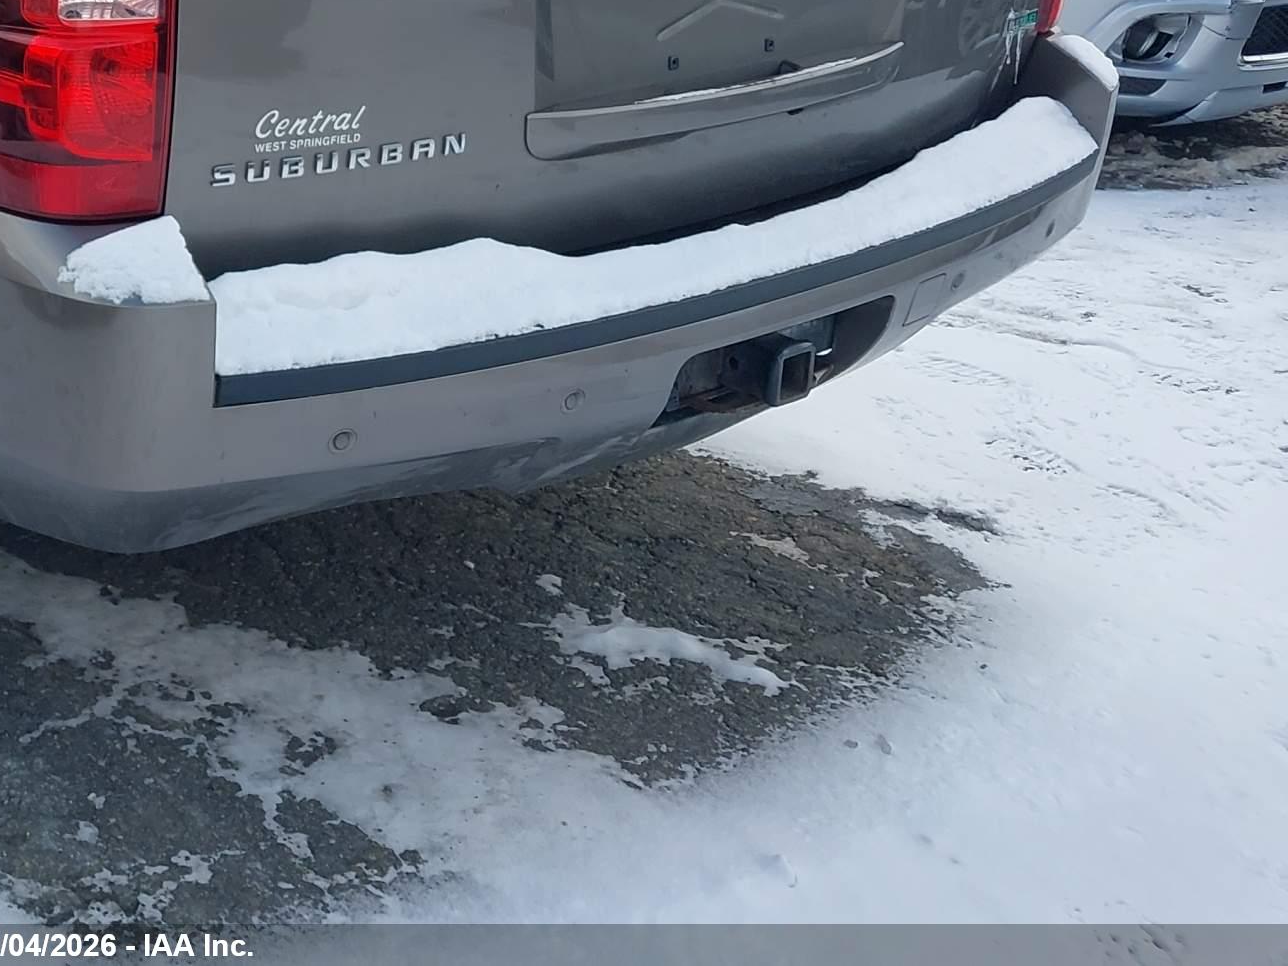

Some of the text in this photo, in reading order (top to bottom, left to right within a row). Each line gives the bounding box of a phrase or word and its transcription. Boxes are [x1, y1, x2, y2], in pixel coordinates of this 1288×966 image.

[255, 105, 366, 139] Central
[211, 133, 467, 187] SUBURBAN
[255, 133, 361, 153] WEST SPRINGFIELD
